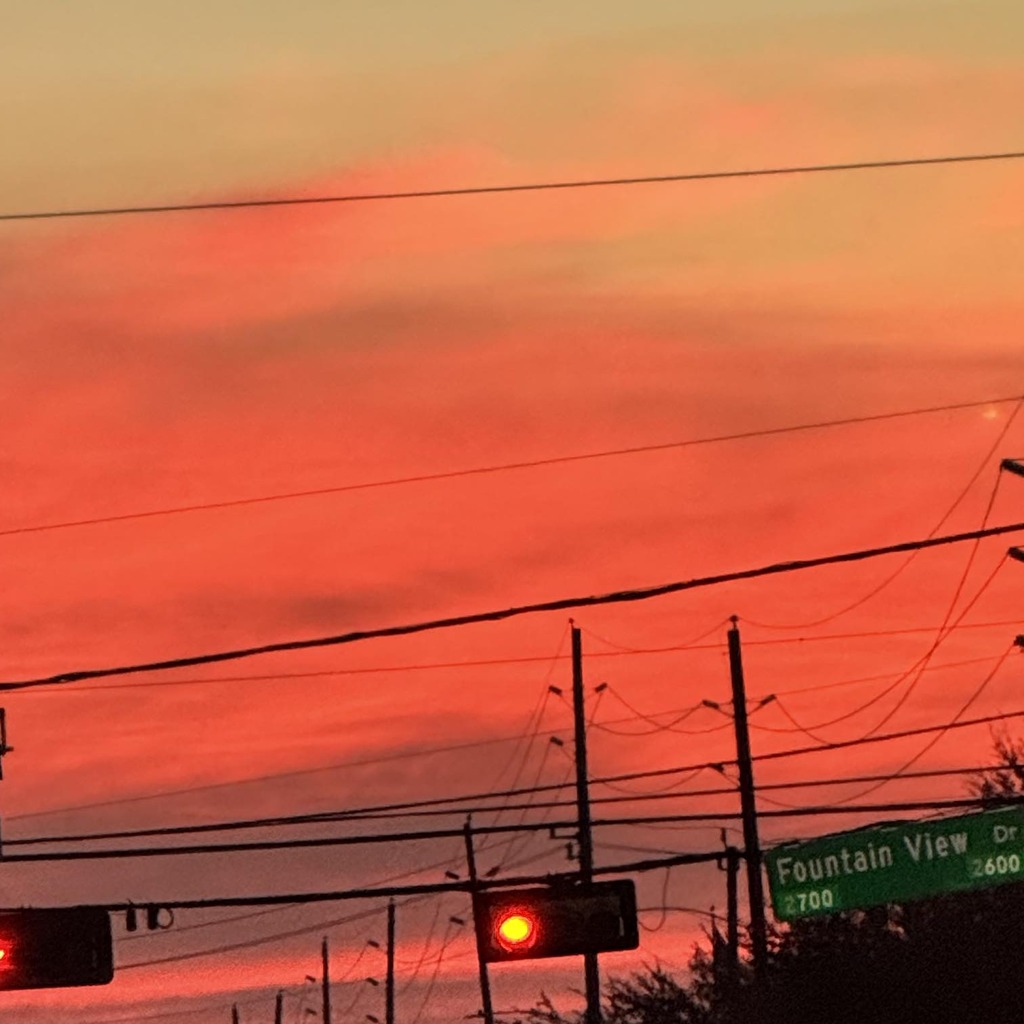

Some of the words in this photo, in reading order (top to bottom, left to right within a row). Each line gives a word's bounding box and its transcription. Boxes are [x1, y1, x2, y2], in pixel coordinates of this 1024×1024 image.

[776, 842, 894, 885] Fountain
[904, 831, 968, 862] View
[993, 825, 1018, 844] Dr
[971, 853, 1021, 878] 2600
